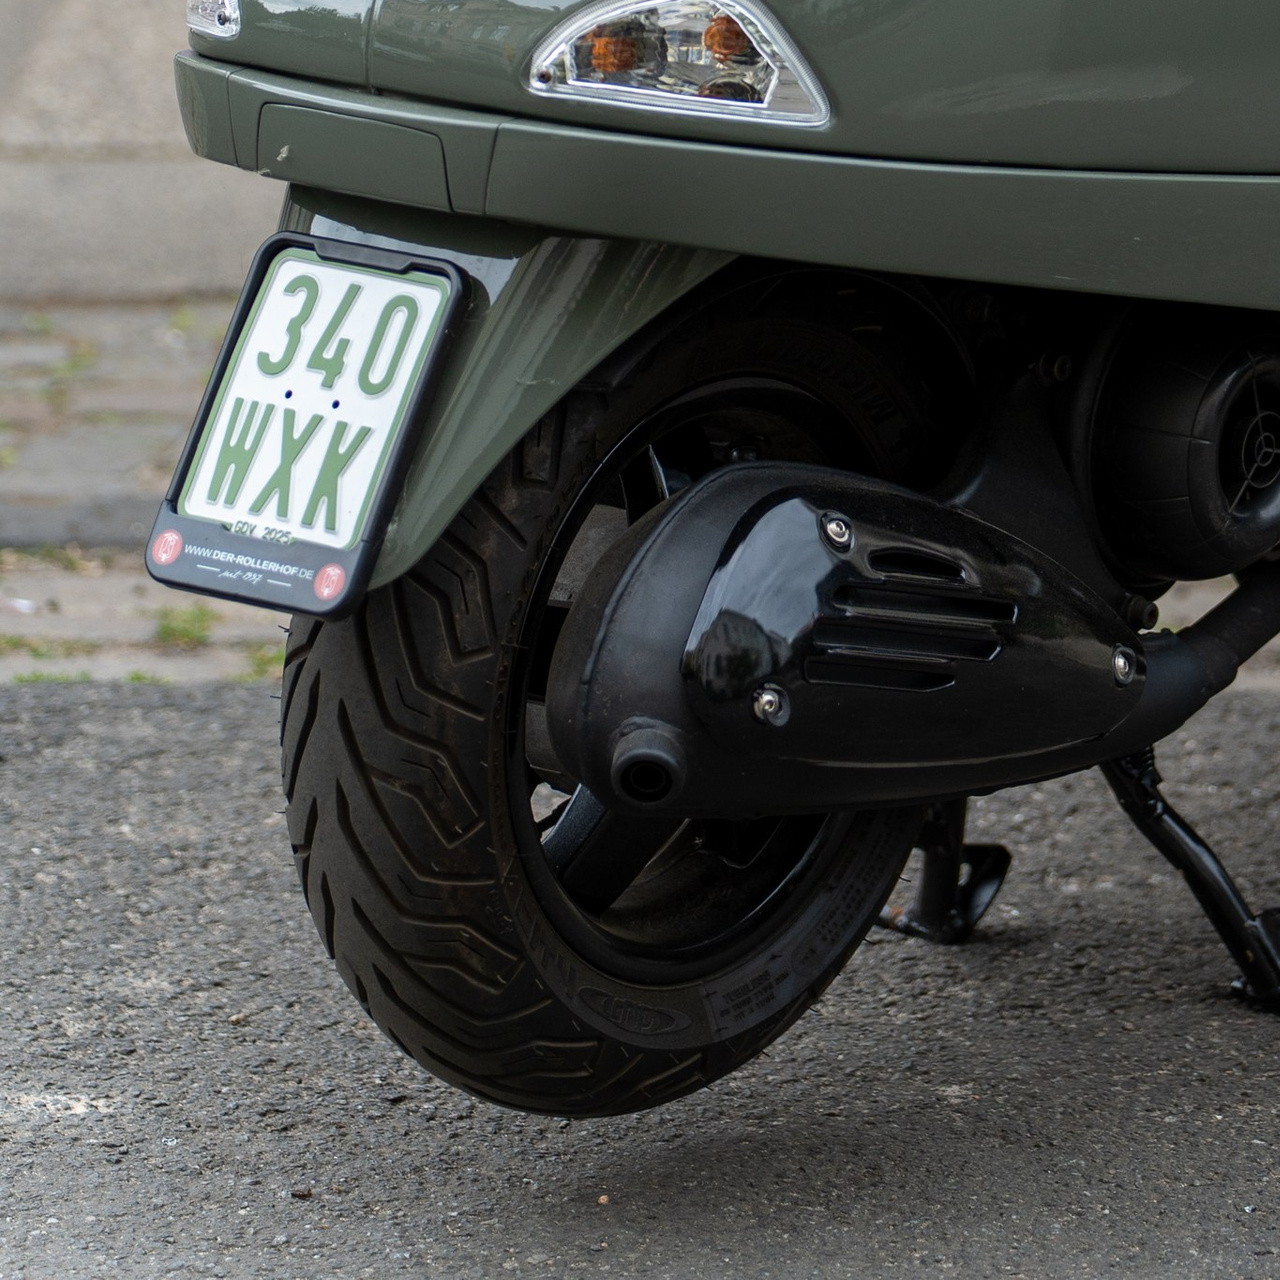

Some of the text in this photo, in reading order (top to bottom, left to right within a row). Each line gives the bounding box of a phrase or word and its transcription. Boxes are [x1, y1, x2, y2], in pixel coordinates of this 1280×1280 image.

[257, 274, 419, 396] 340
[206, 397, 373, 531] WXK
[184, 544, 315, 580] WWW.DER-ROLLERHOF.DE
